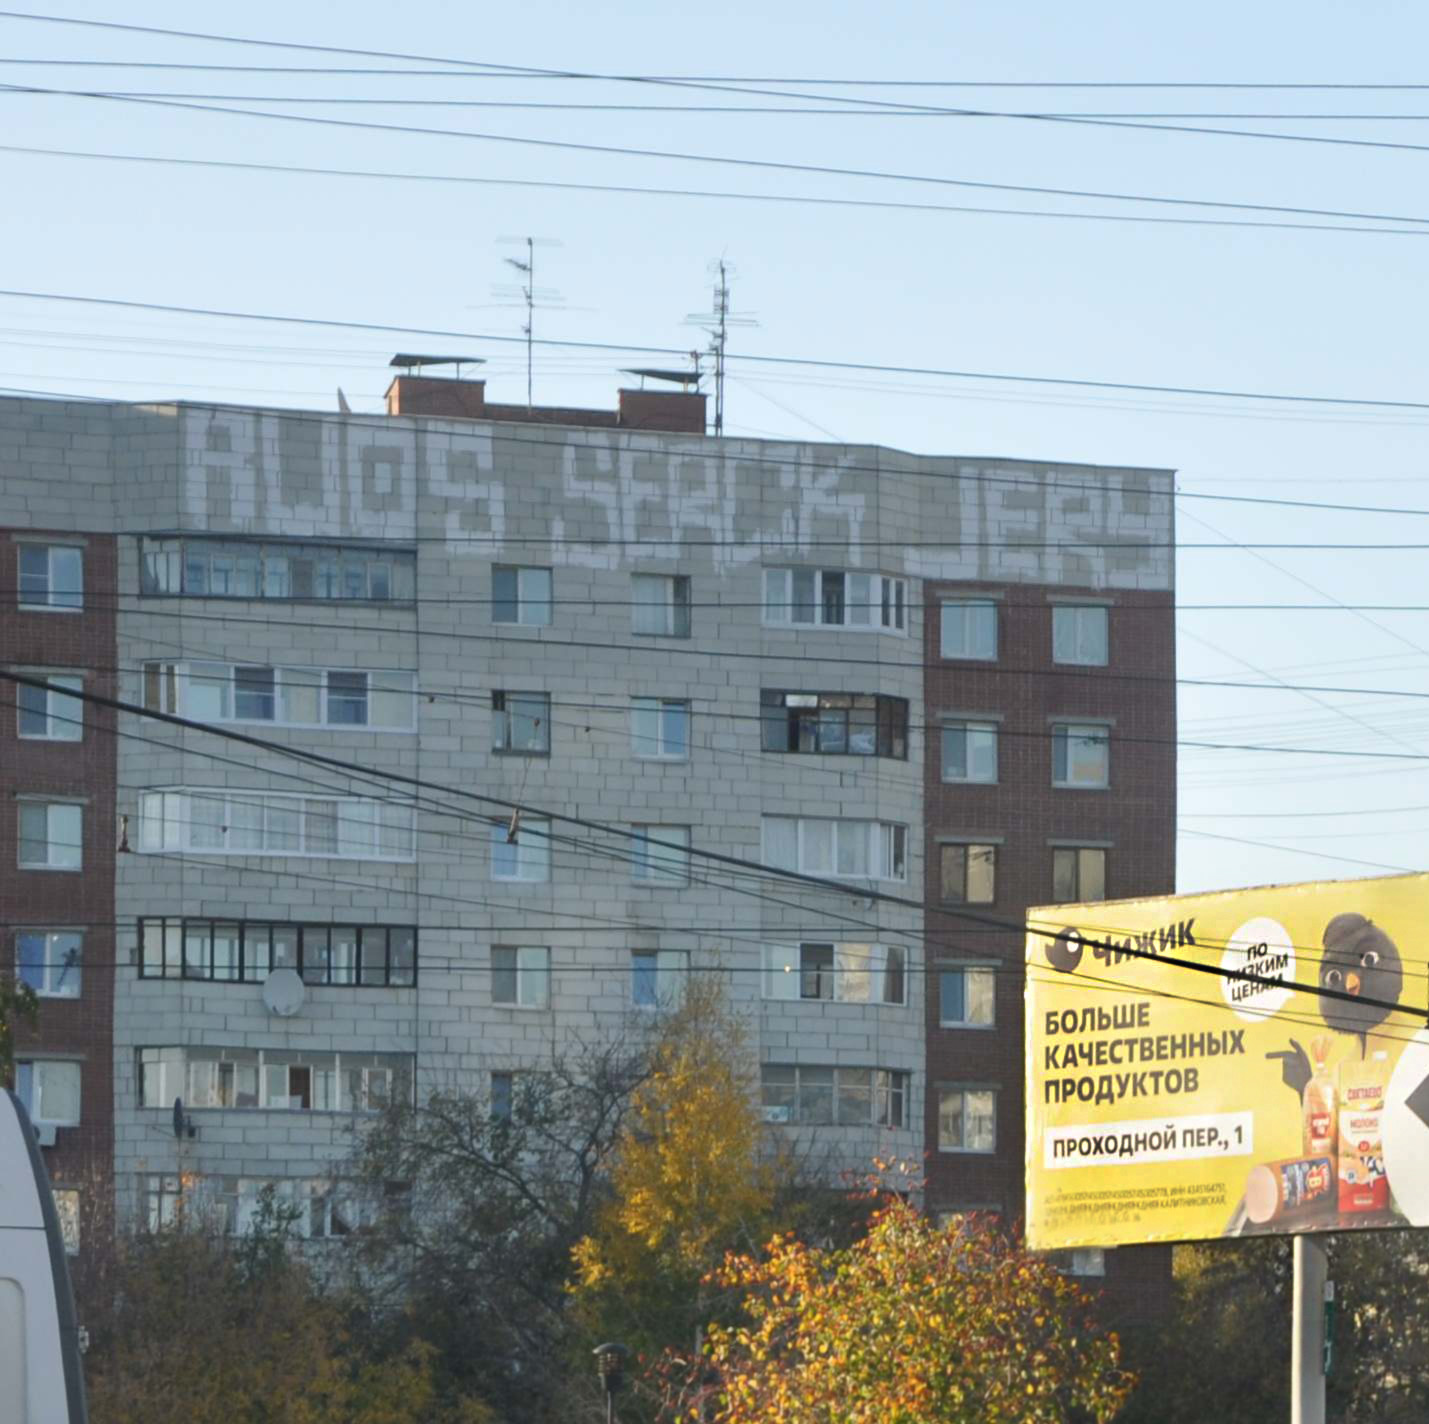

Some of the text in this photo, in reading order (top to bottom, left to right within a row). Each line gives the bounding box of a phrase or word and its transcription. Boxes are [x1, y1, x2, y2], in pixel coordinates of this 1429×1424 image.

[1092, 917, 1196, 967] ЧИЖИК
[1247, 942, 1268, 961] ПО
[1045, 1002, 1150, 1035] БОЛЬШЕ
[1045, 1029, 1245, 1070] КАЧЕСТВЕННЫХ
[1044, 1068, 1199, 1105] ПРОДУКТОВ
[1053, 1124, 1244, 1158] ПРОХОДНОЙ ПЕР., 1
